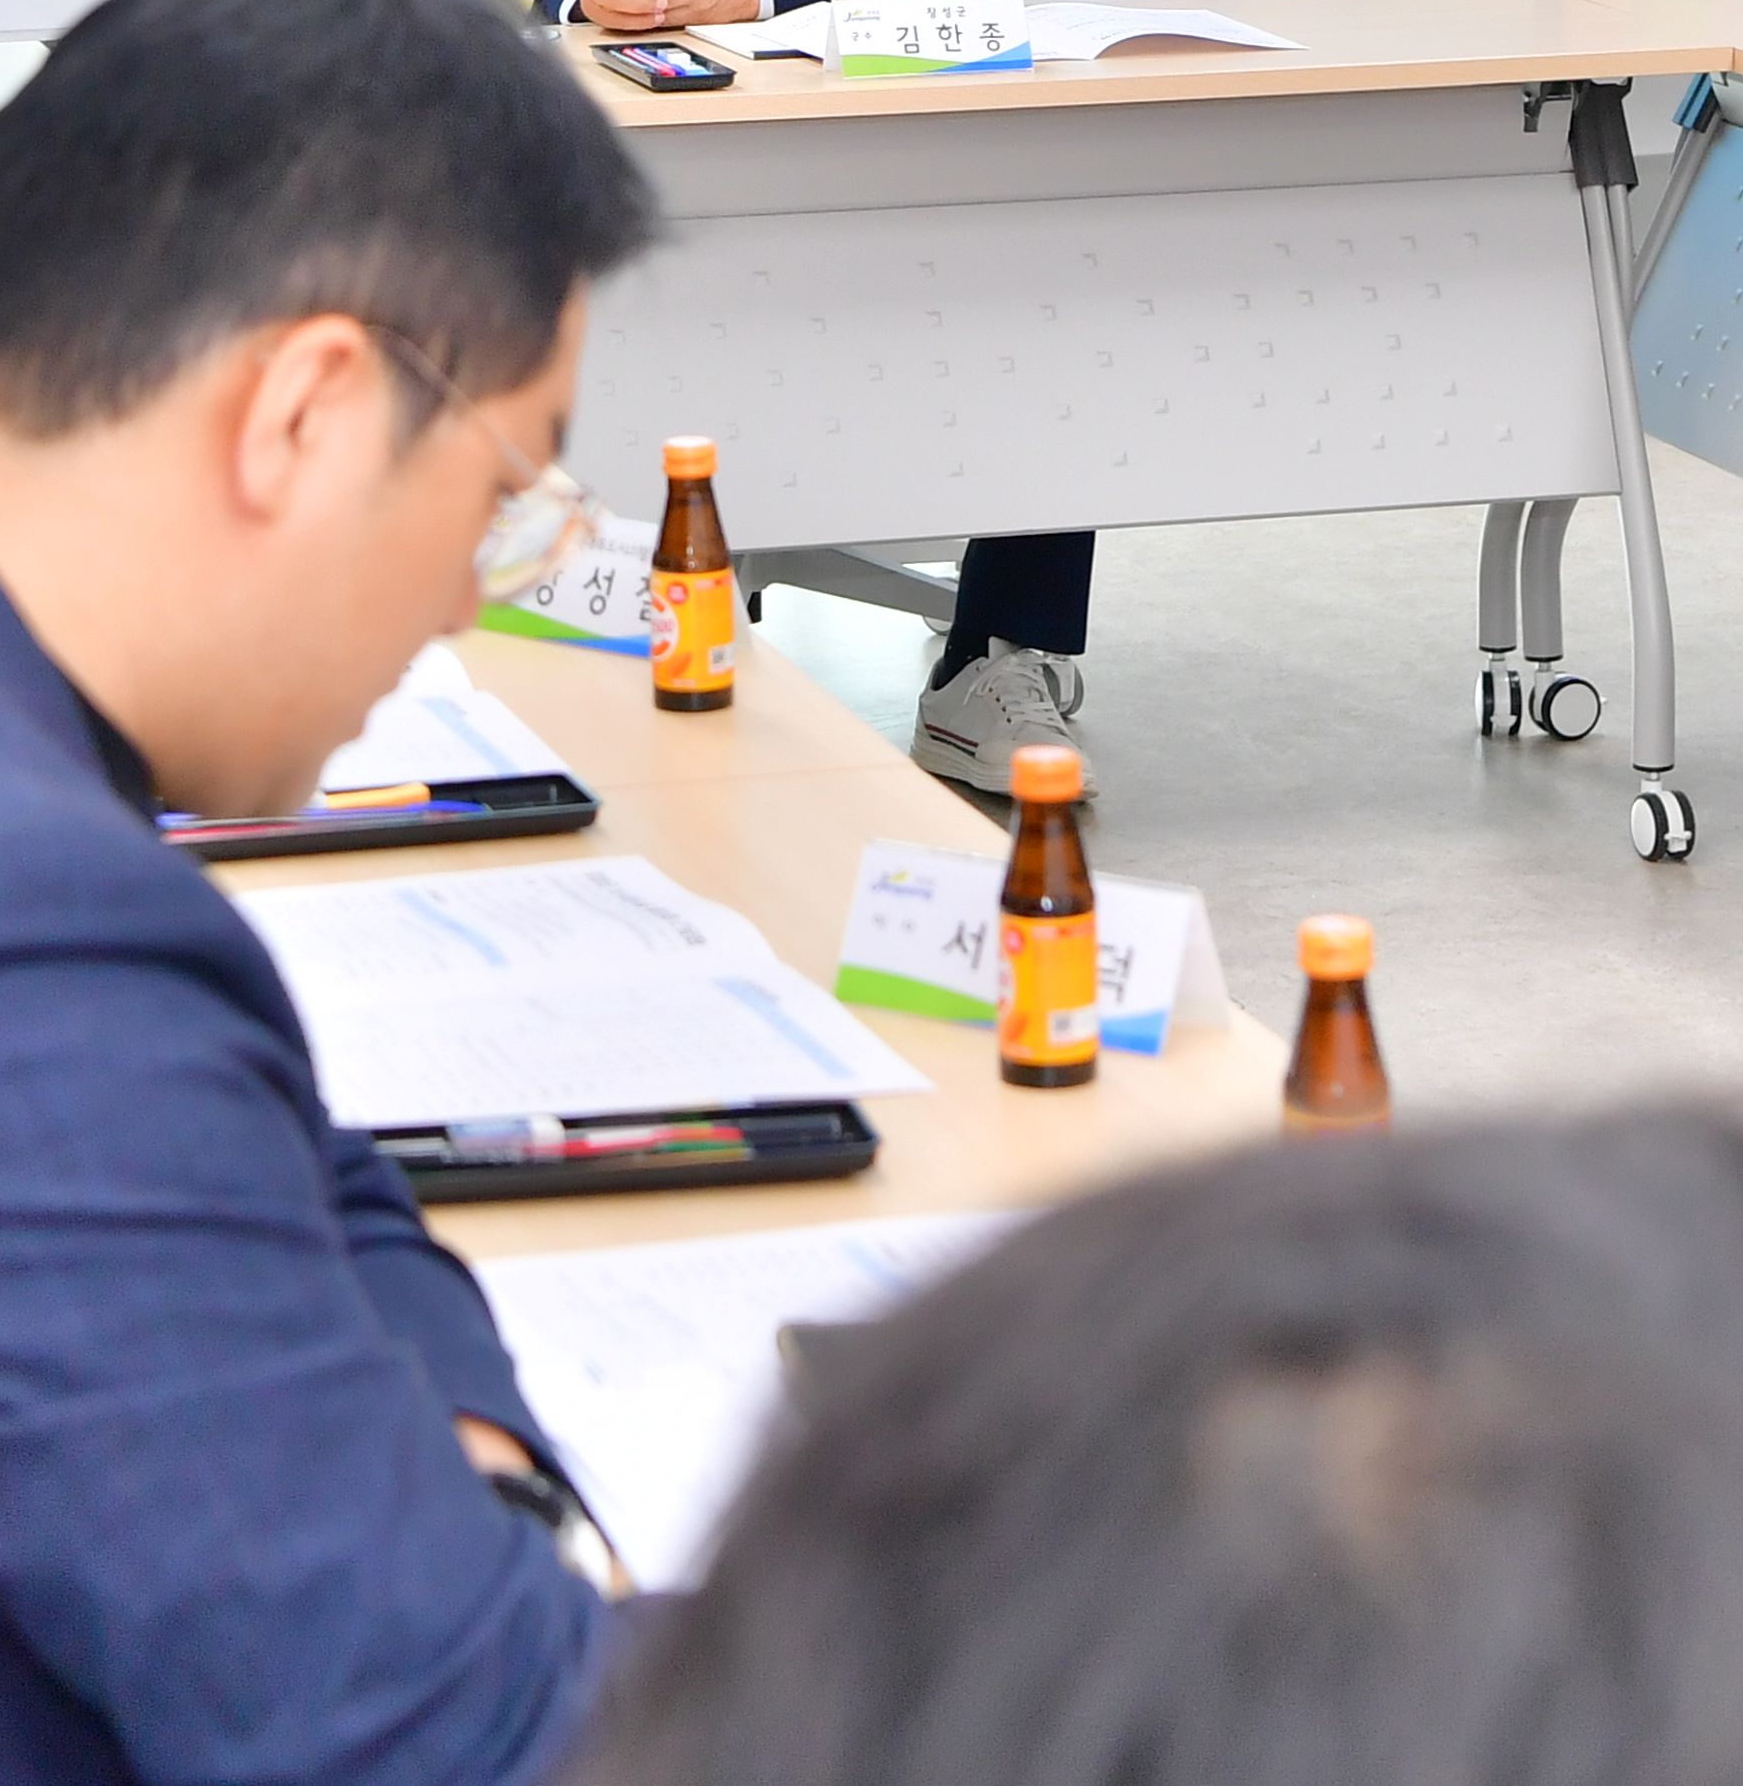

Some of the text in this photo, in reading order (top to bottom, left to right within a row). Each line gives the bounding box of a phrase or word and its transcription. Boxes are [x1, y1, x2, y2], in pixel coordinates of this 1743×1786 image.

[926, 5, 967, 20] 장성군
[895, 22, 1006, 55] 김한종
[942, 919, 1136, 1004] 서덕
